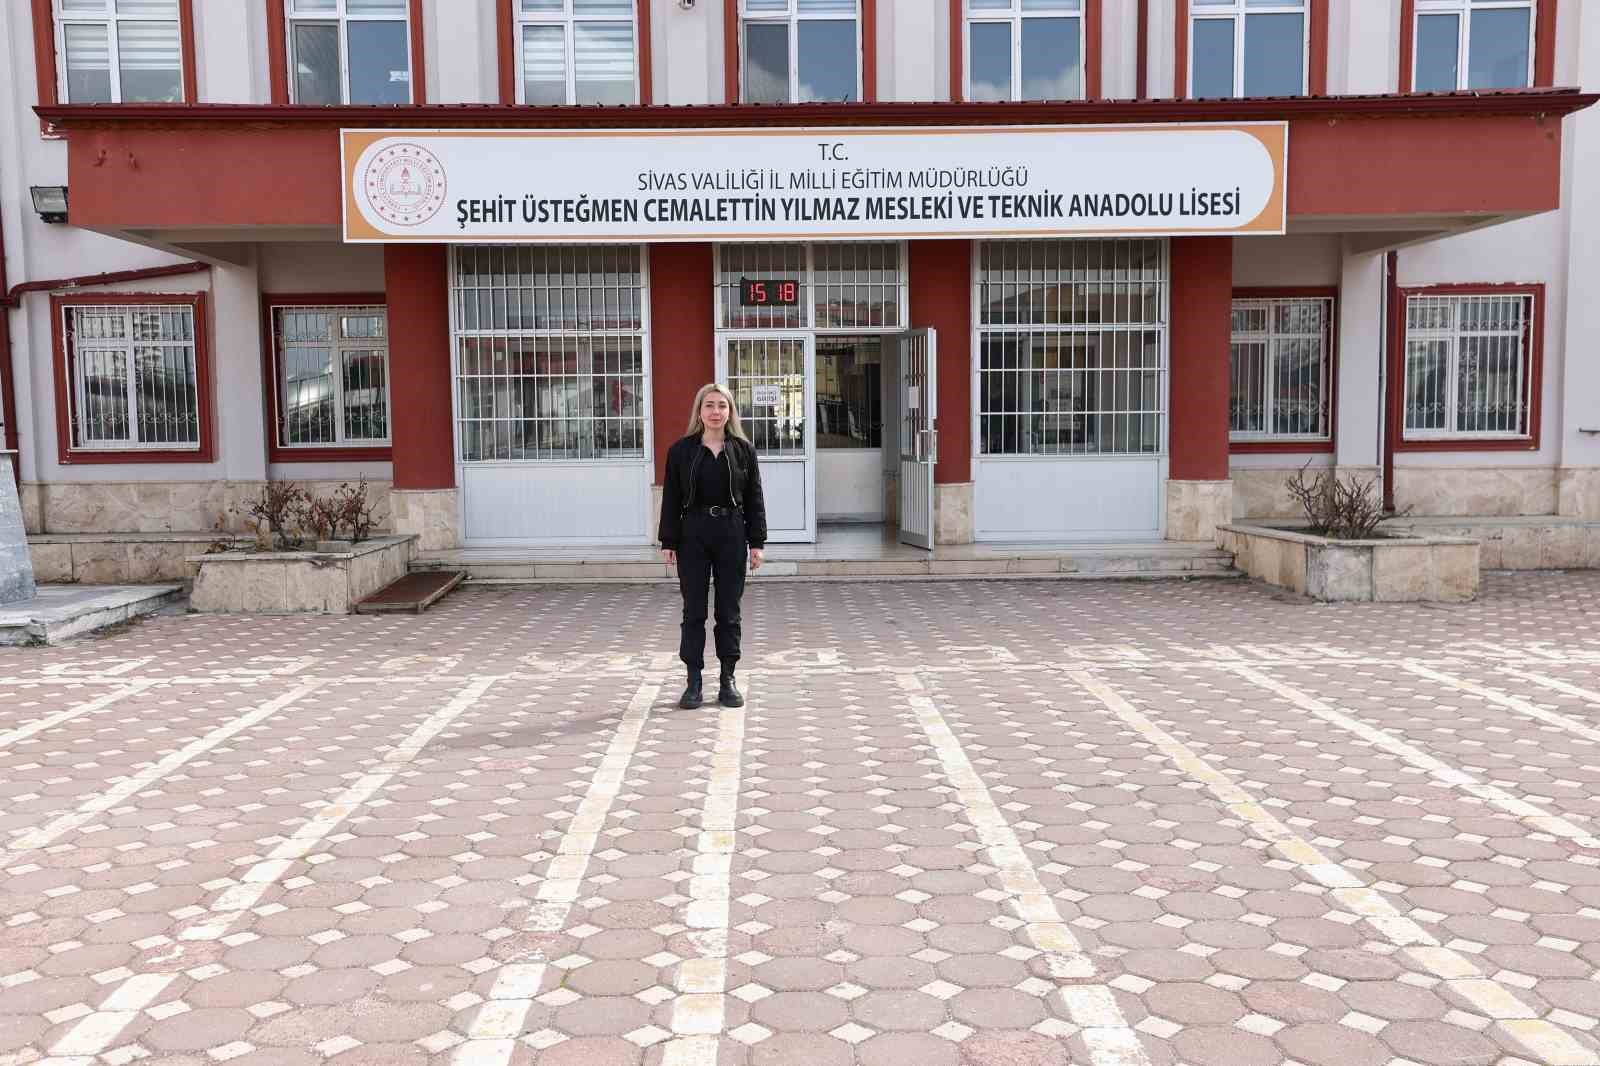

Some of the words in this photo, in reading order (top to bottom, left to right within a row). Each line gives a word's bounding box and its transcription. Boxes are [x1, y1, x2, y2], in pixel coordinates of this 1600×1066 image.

[817, 143, 849, 161] T.C.
[638, 169, 689, 191] SİVAS
[691, 168, 764, 190] VALİLİĞİ
[770, 168, 785, 190] İL
[789, 168, 836, 190] MİLLİ
[841, 167, 904, 189] EĞİTİM
[908, 166, 1028, 188] MÜDÜRLÜĞÜ
[456, 194, 518, 230] ŞEHİT
[522, 194, 639, 223] ÜSTEĞMEN
[643, 192, 777, 222] CEMALETTİN
[780, 198, 860, 221] YILMAZ
[864, 190, 954, 220] MESLEKİ
[957, 195, 985, 219] VE
[987, 189, 1064, 219] TEKNİK
[1068, 193, 1173, 217] ANADOLU
[1179, 187, 1241, 216] LİSESİ
[750, 282, 767, 302] 15
[779, 282, 795, 302] 18
